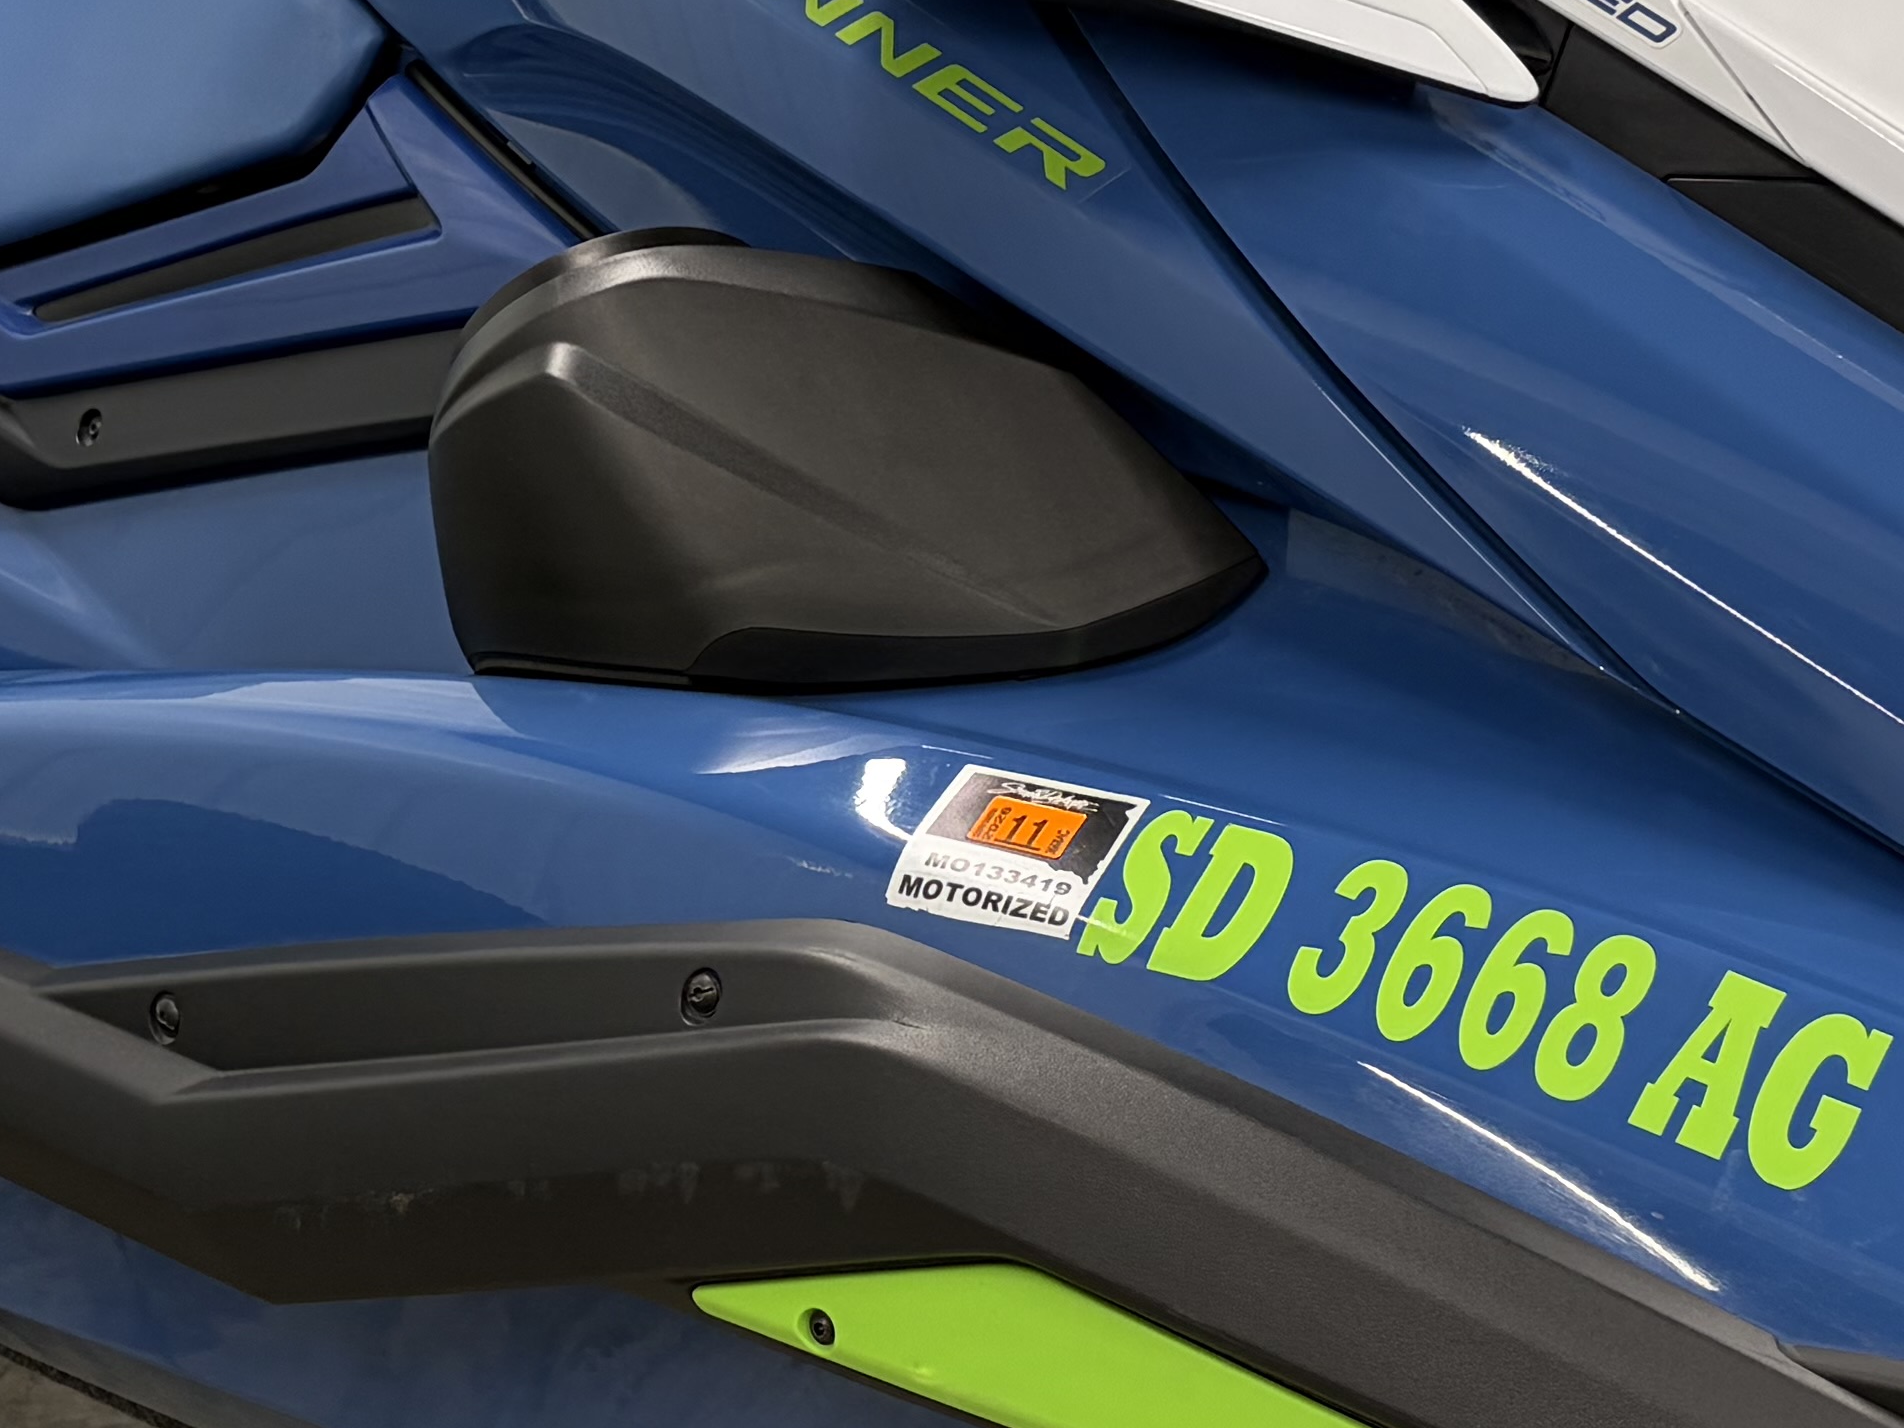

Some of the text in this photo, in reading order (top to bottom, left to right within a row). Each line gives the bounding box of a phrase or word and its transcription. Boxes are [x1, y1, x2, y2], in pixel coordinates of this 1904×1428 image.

[1007, 814, 1049, 846] 11
[898, 873, 1070, 927] MOTORIZED
[1076, 809, 1894, 1190] SD 3668 AG
